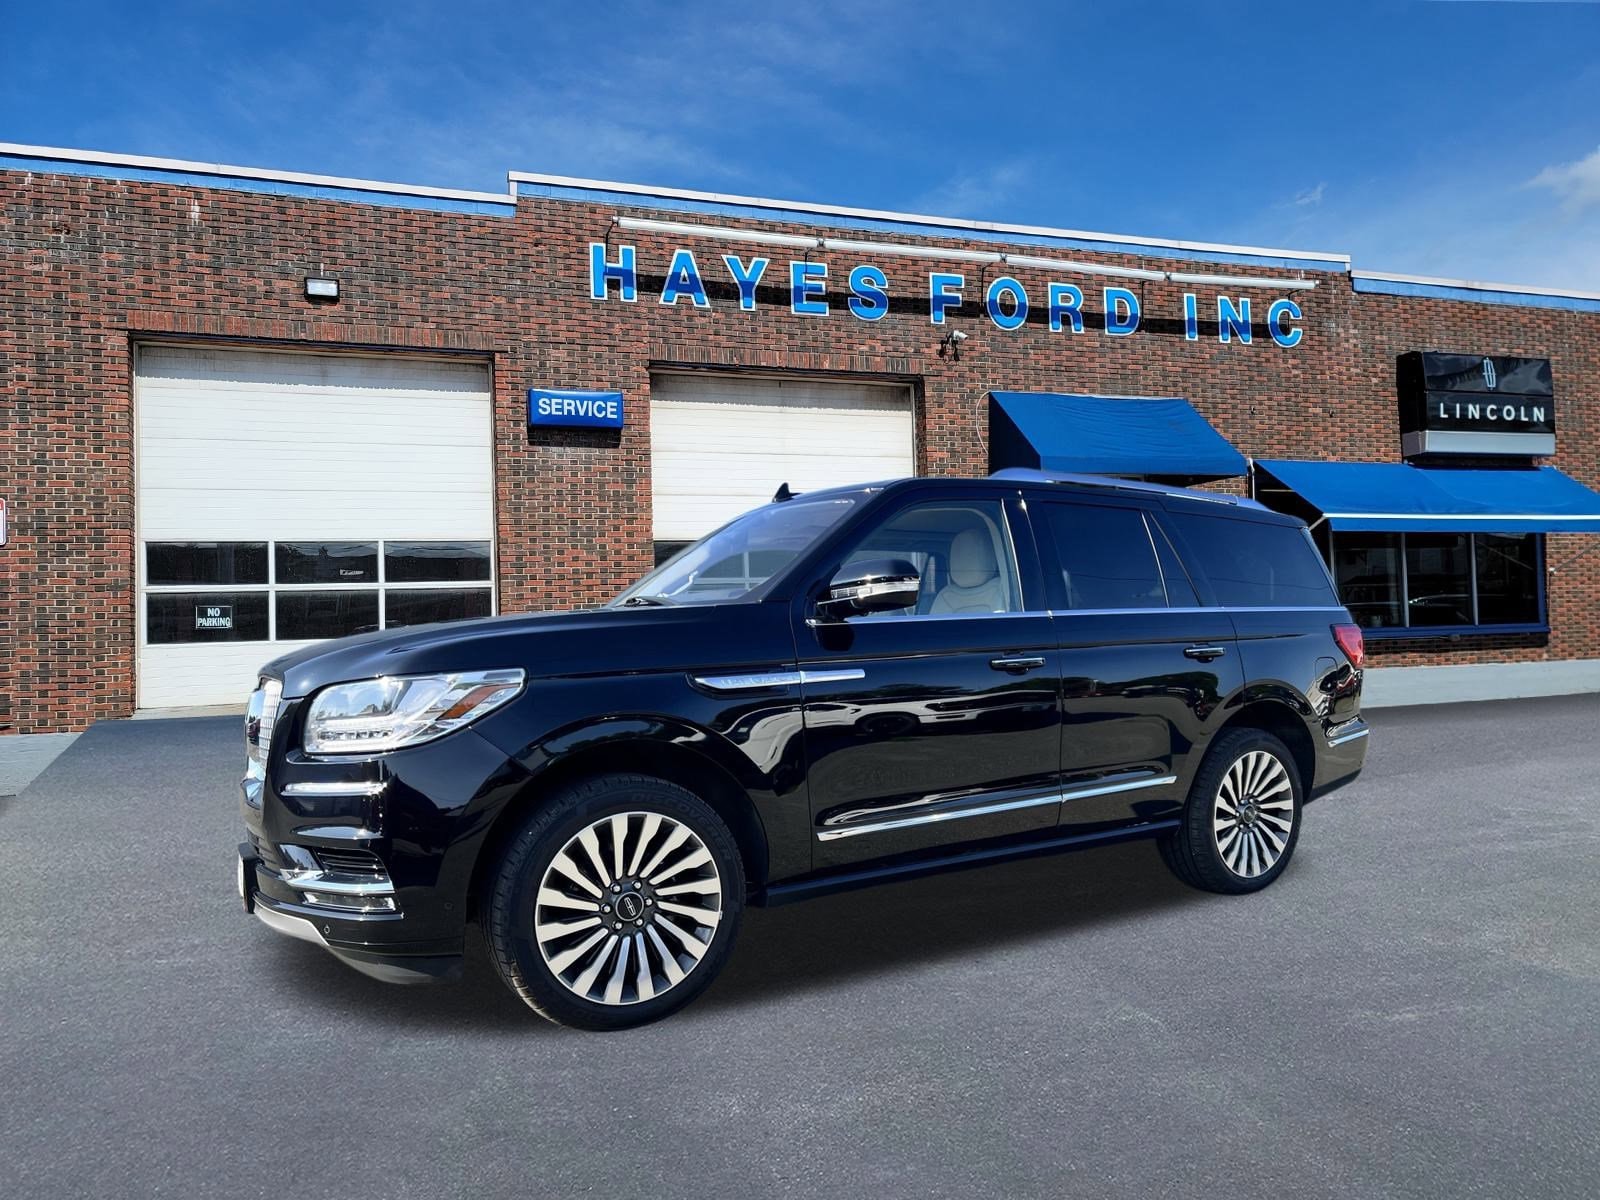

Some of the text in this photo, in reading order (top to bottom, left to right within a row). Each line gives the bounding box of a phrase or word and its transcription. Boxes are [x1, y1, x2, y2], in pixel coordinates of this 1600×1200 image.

[589, 242, 1303, 348] HAYES FORD INC
[538, 398, 617, 419] SERVICE
[1439, 402, 1545, 422] LINCOLN
[197, 617, 231, 627] PARKING
[207, 607, 221, 617] NO
